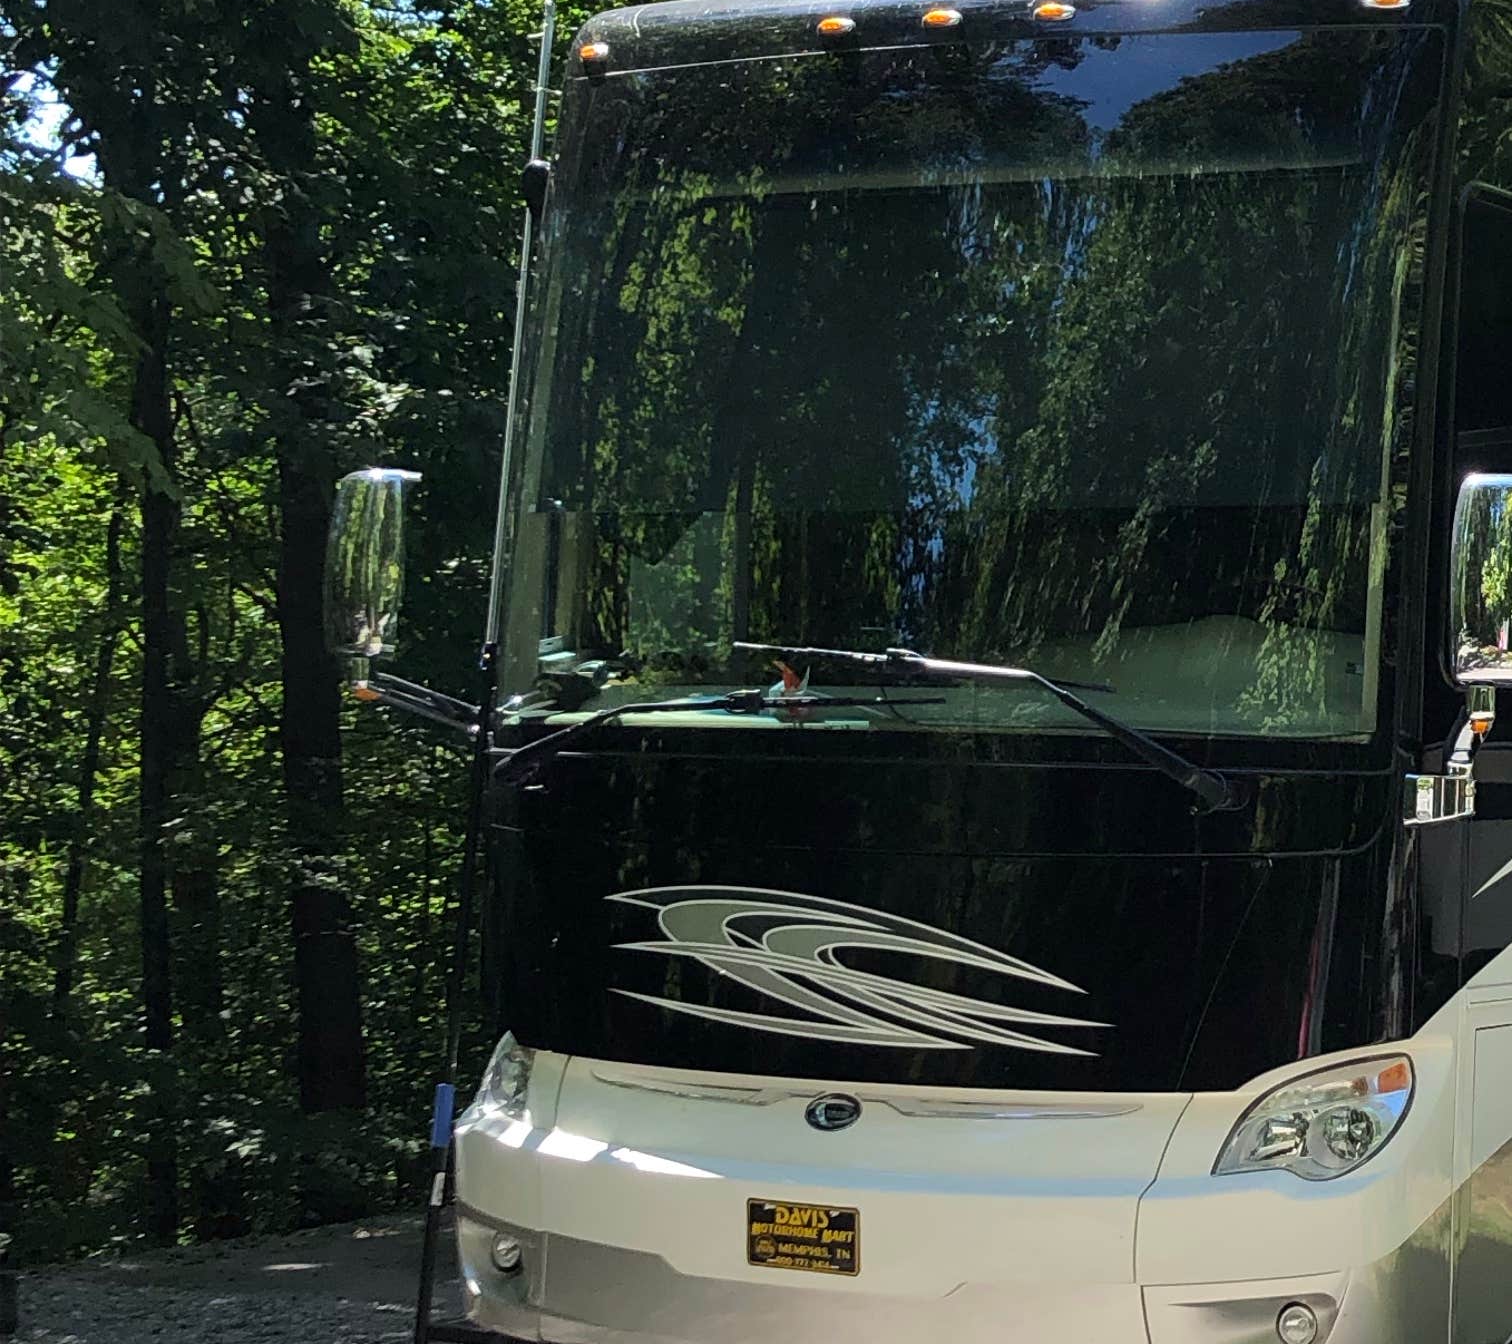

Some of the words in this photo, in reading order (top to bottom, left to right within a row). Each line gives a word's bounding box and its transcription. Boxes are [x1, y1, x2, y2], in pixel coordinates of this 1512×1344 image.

[775, 1206, 829, 1229] DAVIS
[751, 1222, 819, 1238] MOTORHOME
[821, 1228, 855, 1243] MART
